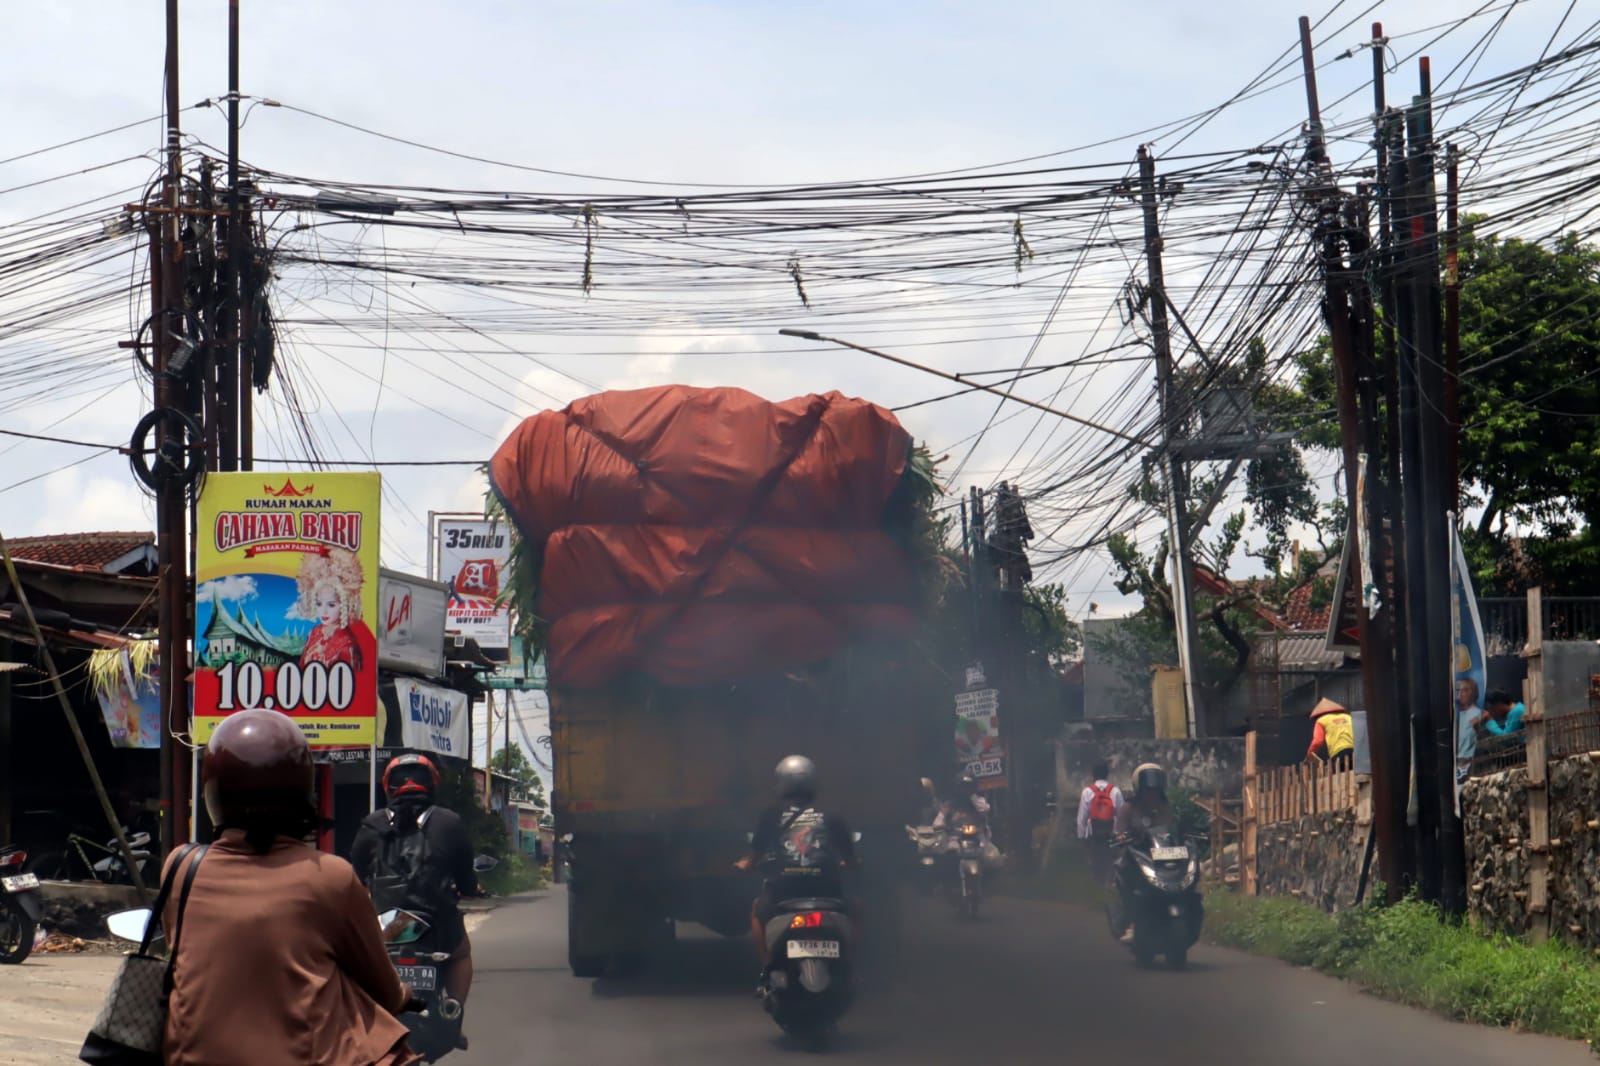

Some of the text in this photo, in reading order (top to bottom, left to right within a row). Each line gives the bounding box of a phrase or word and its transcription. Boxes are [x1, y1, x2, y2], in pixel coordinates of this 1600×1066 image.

[245, 499, 332, 508] RUMAH MAKAN
[216, 512, 362, 551] CAHAYA BARU
[255, 543, 321, 553] MASAKAN PADANG
[217, 661, 355, 711] 10.000
[422, 695, 452, 729] blibli
